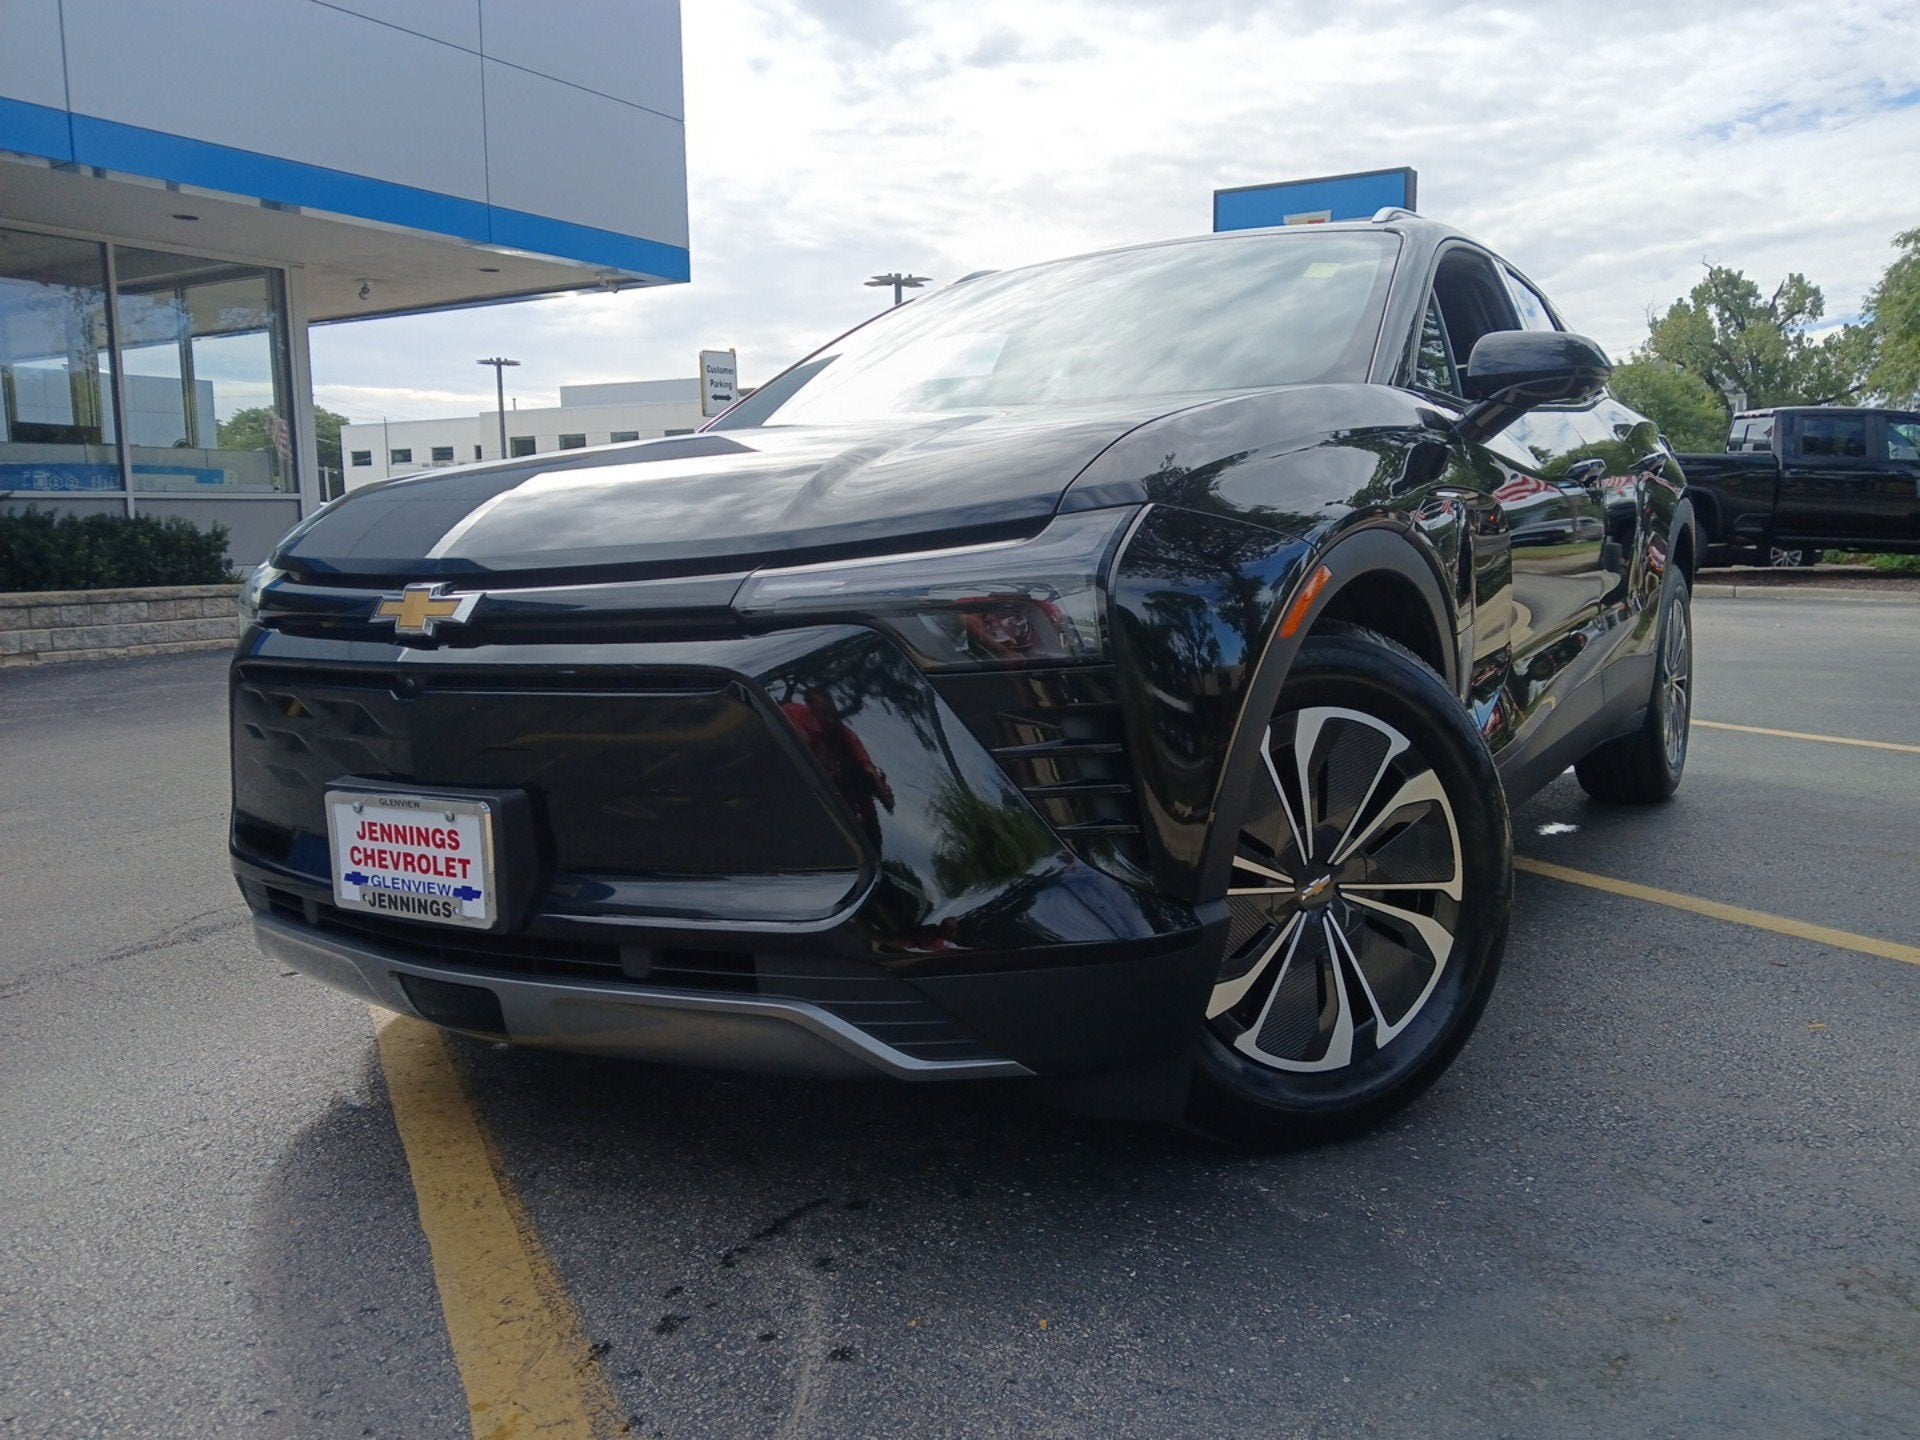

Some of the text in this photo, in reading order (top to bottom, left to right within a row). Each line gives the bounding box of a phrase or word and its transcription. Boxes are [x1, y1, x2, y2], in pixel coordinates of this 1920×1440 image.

[706, 364, 734, 375] Customer
[710, 379, 732, 391] Parking
[379, 797, 421, 809] GLENVIEW
[356, 820, 461, 851] JENNINGS
[350, 845, 471, 879] CHEVROLET
[371, 874, 452, 896] GLENVIEW
[368, 891, 453, 919] JENNINGS
